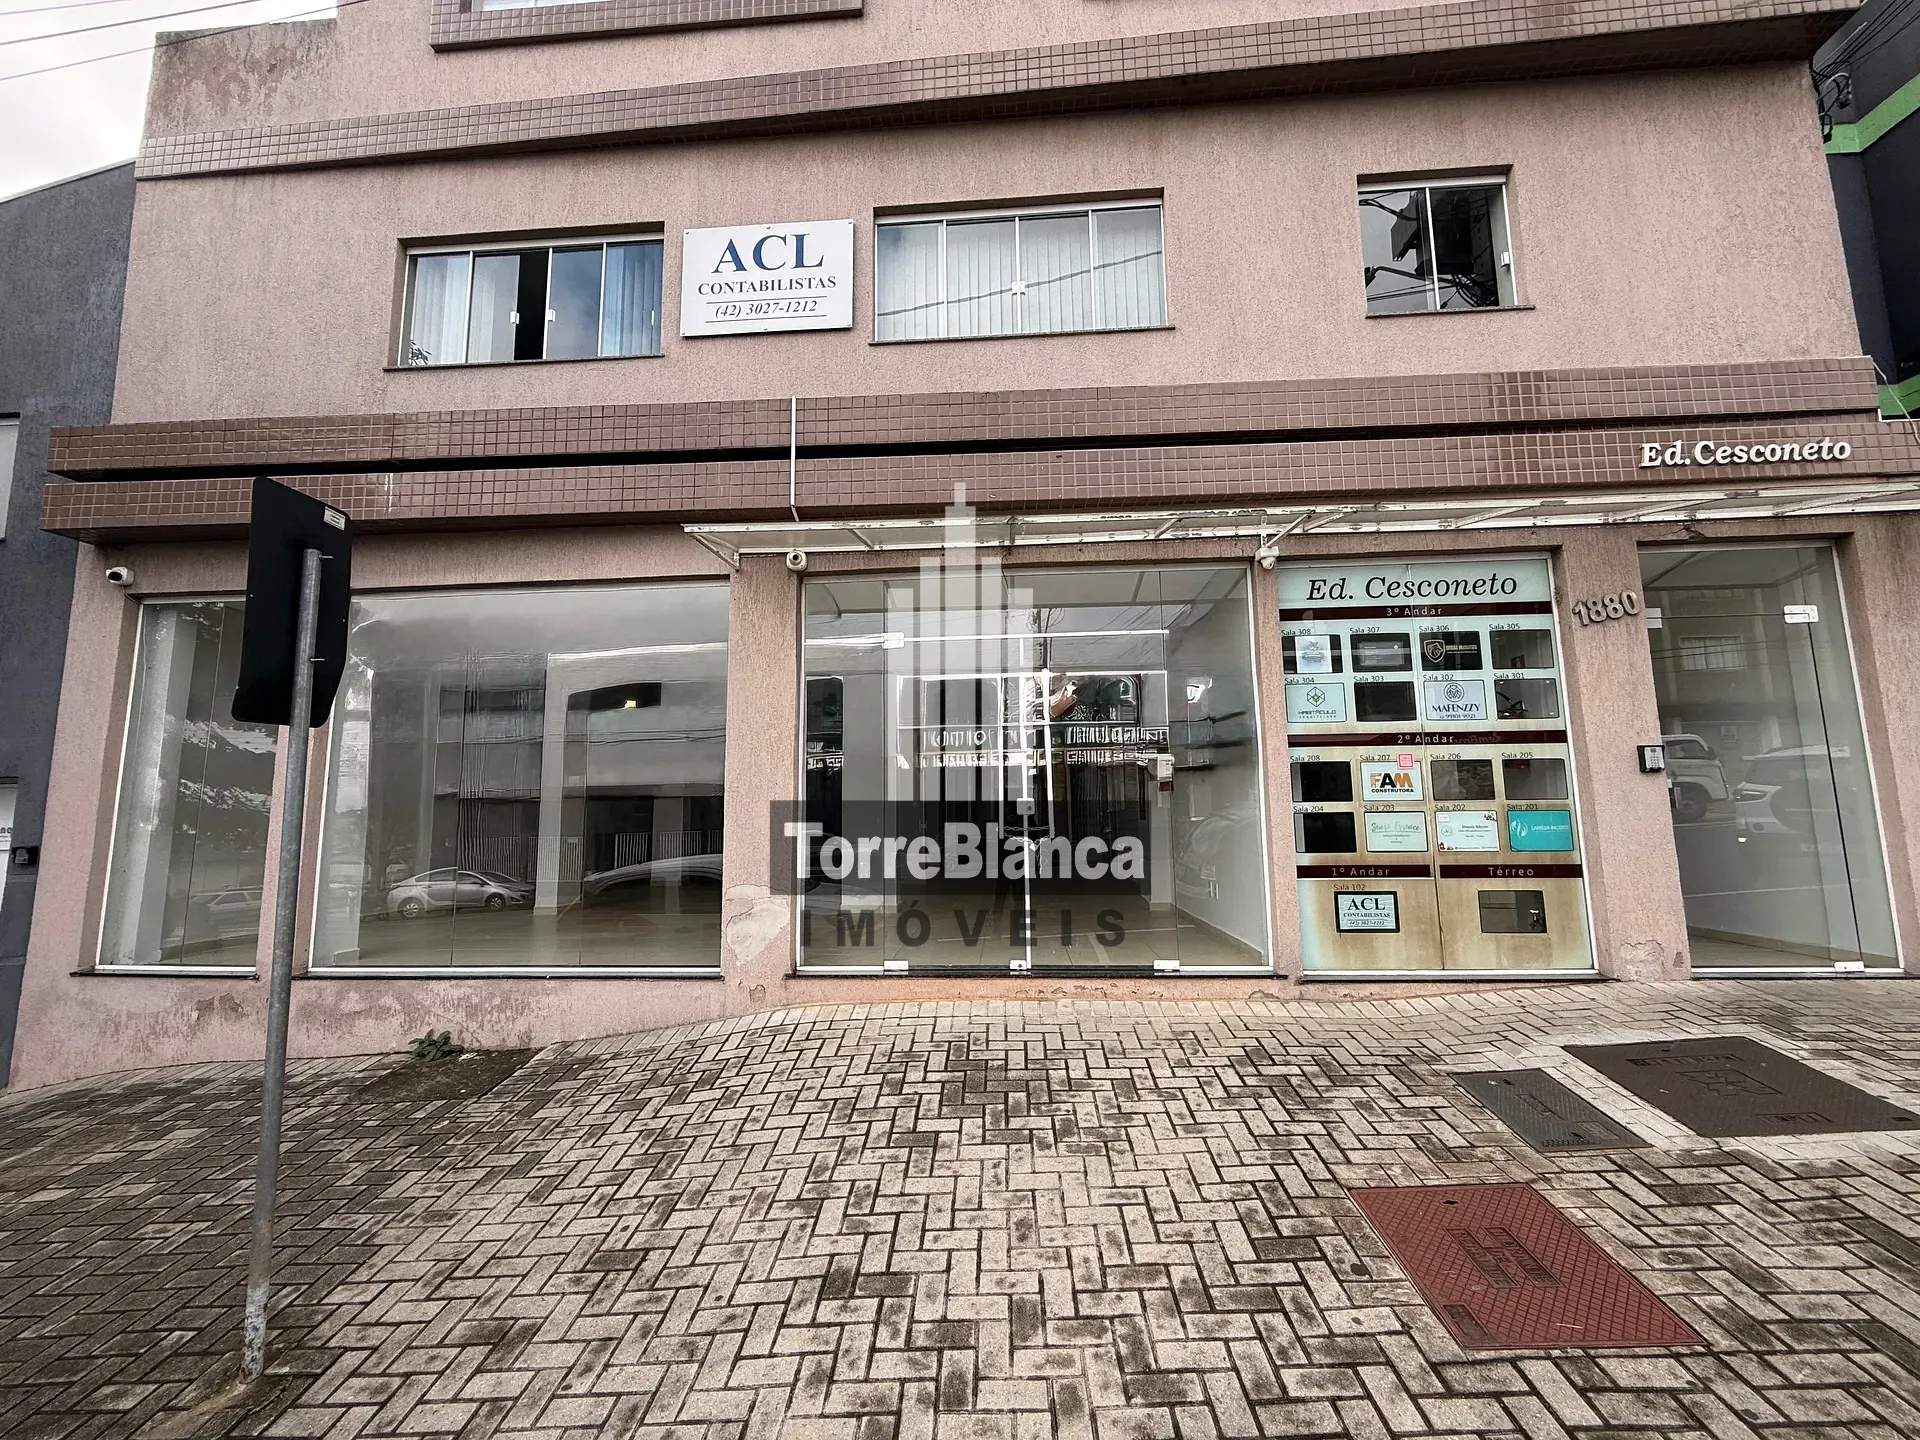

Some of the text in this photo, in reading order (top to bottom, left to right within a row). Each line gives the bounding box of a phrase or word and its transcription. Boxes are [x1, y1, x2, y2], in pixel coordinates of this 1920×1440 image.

[711, 233, 824, 274] ACL
[698, 276, 836, 295] CONTABILISTAS
[715, 300, 817, 319] (42) 3027-1212
[1306, 572, 1518, 601] Ed. Cesconeto
[1404, 606, 1443, 617] Andar
[1572, 589, 1640, 627] 1880
[1366, 626, 1380, 634] 307
[1435, 624, 1450, 632] 306
[1506, 622, 1520, 630] 305
[1298, 628, 1311, 636] 308
[1415, 734, 1454, 744] Andar
[1290, 754, 1305, 762] Sala
[1447, 752, 1462, 760] 206
[1370, 773, 1414, 788] FAM
[1350, 866, 1390, 876] Andar
[1488, 866, 1535, 876] Térreo
[1347, 897, 1386, 910] ACL
